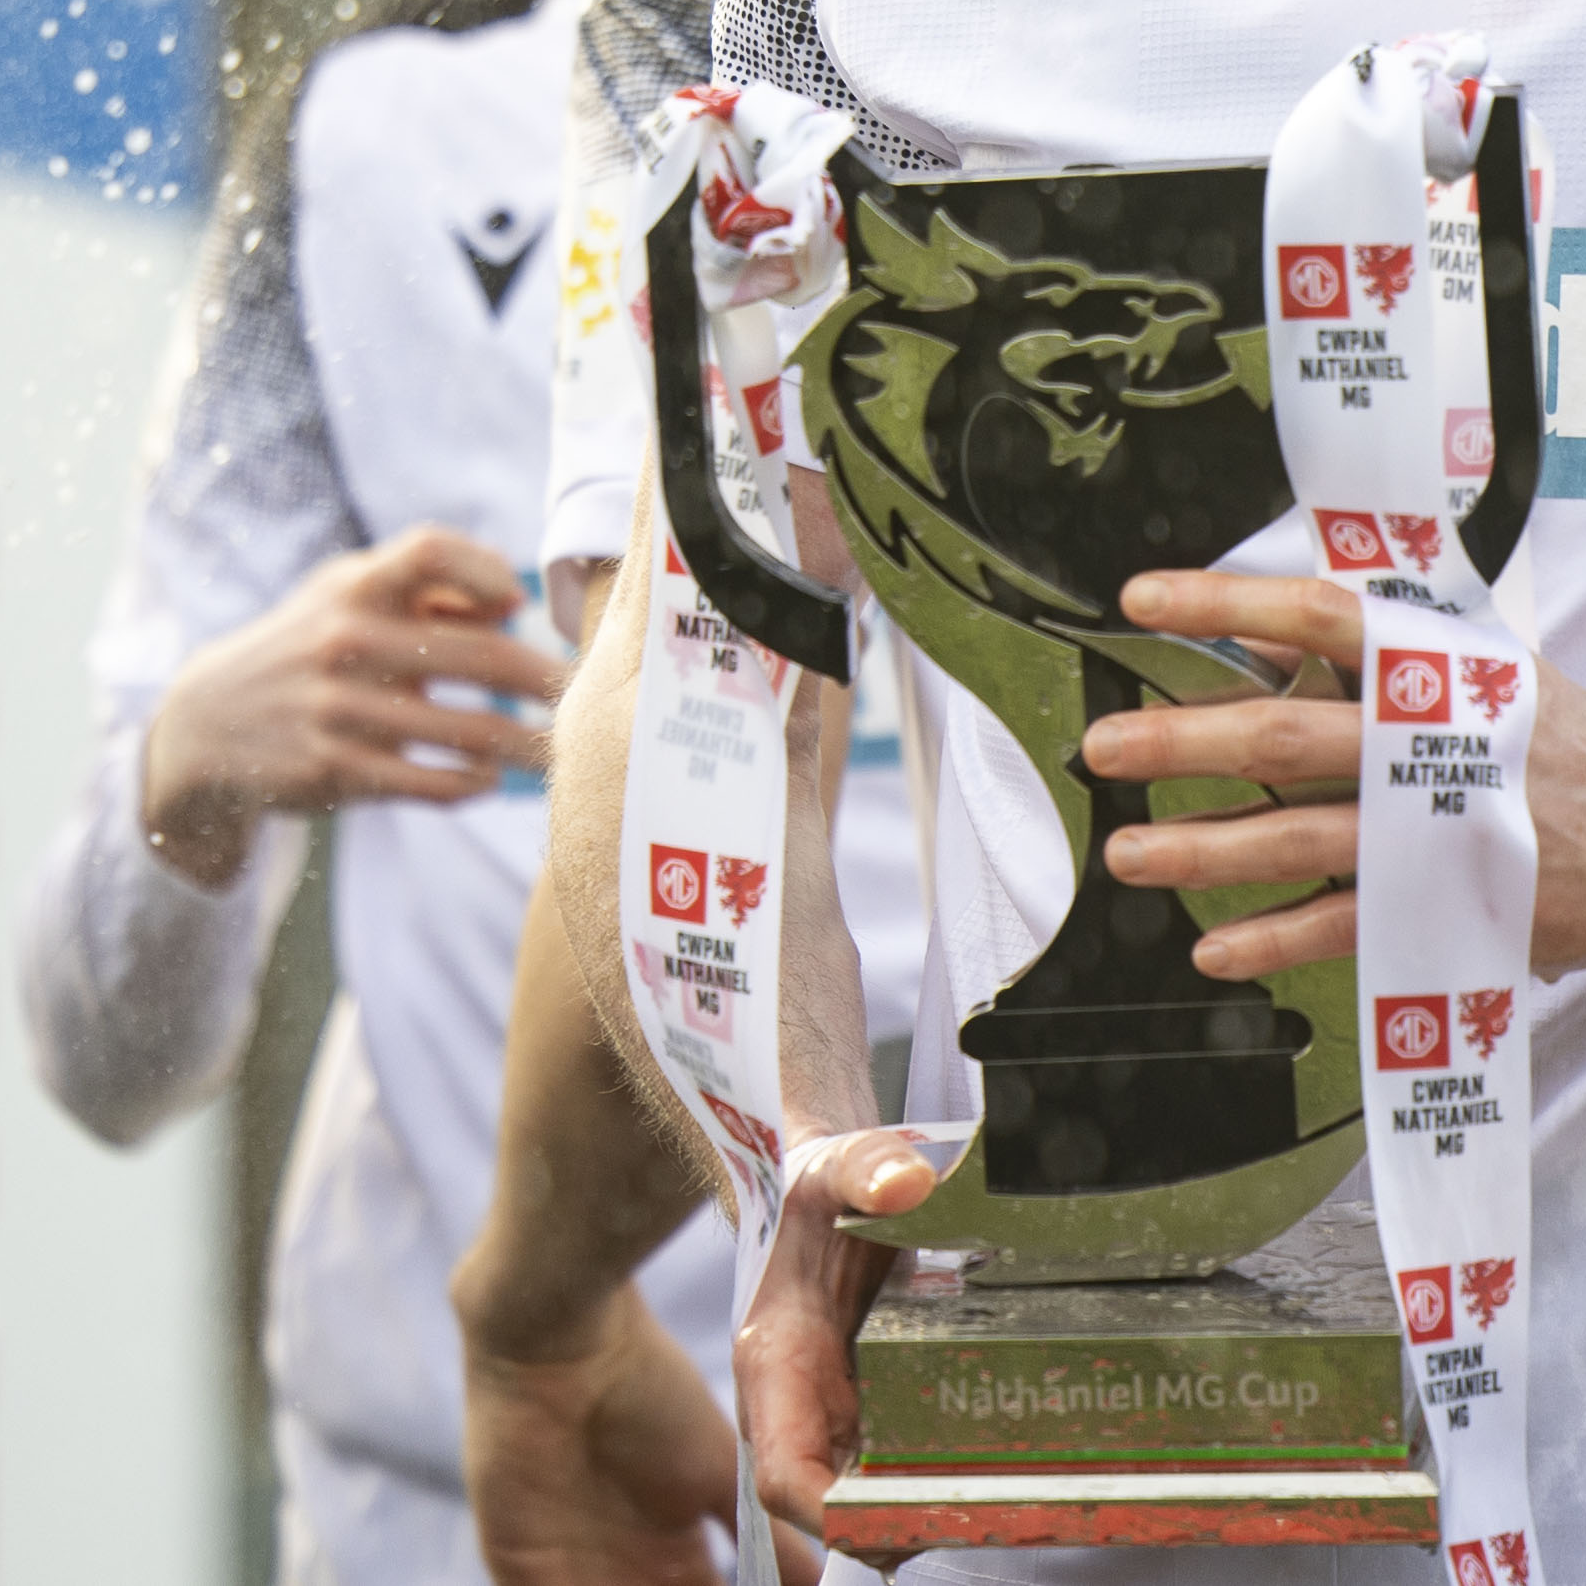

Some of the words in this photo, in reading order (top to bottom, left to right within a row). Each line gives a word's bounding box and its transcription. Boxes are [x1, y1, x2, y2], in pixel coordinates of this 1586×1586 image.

[1317, 329, 1387, 353] CWPAN
[1298, 357, 1409, 382] NATHANIEL
[1340, 384, 1372, 410] MG
[674, 613, 744, 645] NATHA
[710, 647, 738, 674] MG
[1411, 734, 1490, 759] CWPAN
[1388, 762, 1504, 790] NATHANIEL
[1431, 791, 1467, 816] MG
[676, 931, 736, 963] CWPAN
[664, 955, 751, 995] NATHANIEL
[695, 988, 720, 1016] MG
[1411, 1074, 1486, 1104] CWPAN
[1392, 1099, 1504, 1134] NATHANIEL
[1434, 1132, 1465, 1159] MG
[1425, 1344, 1484, 1378] CWPAN
[937, 1374, 1143, 1419] Nathaniel
[1156, 1374, 1223, 1410] MG
[1237, 1371, 1318, 1418] Cup
[1447, 1404, 1470, 1433] MG
